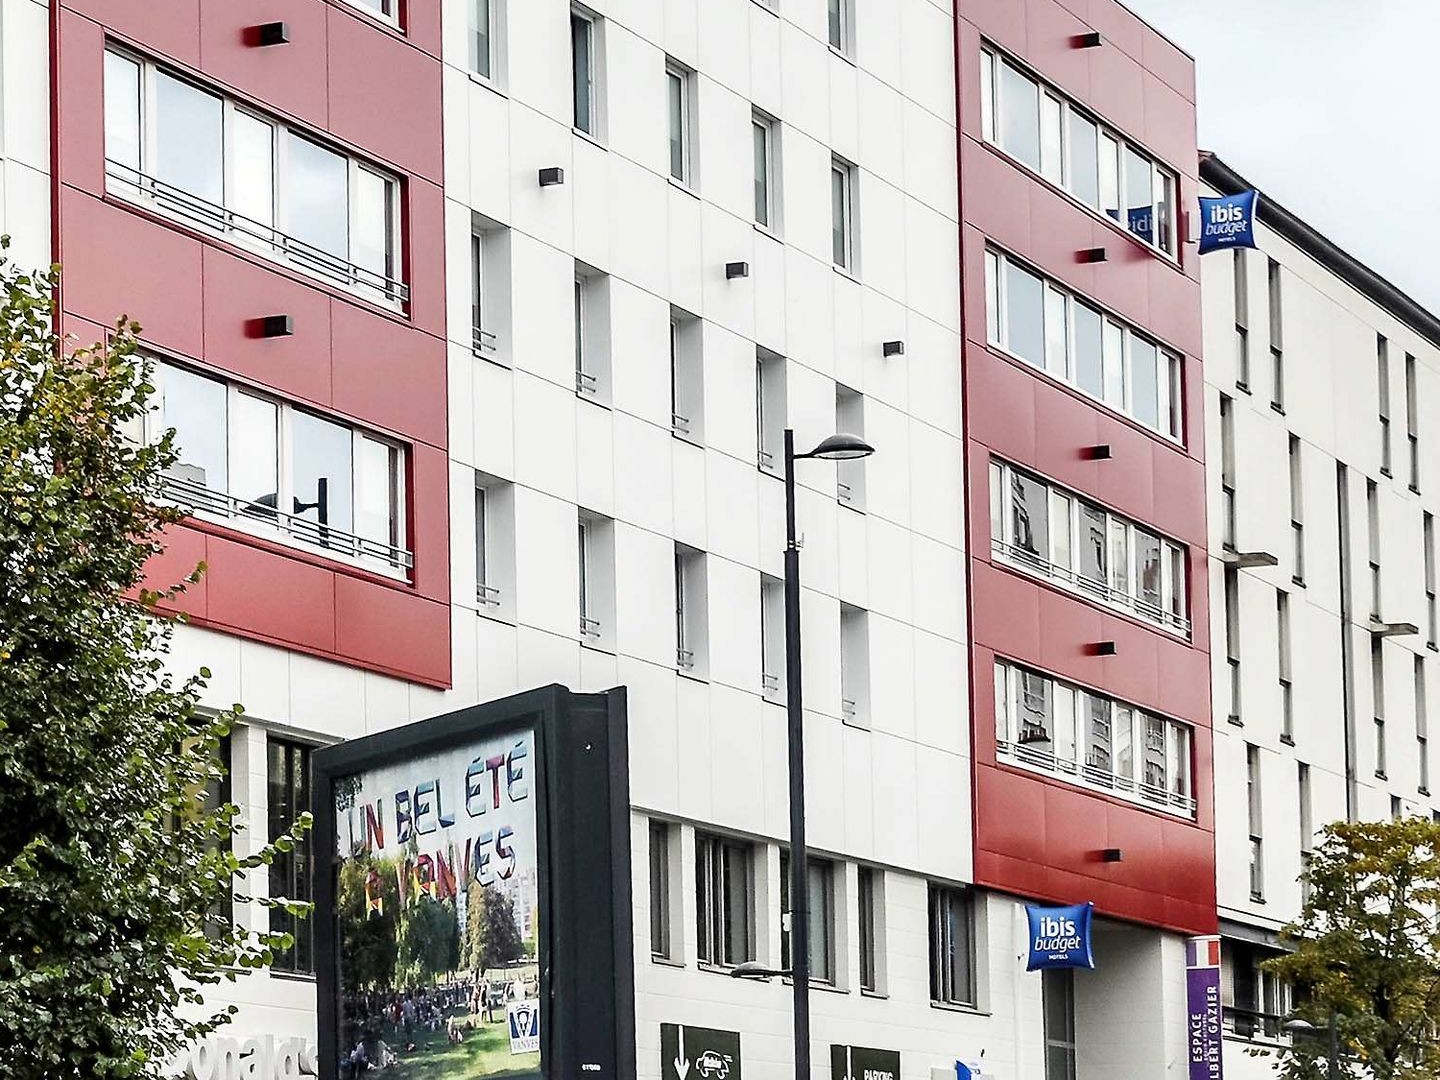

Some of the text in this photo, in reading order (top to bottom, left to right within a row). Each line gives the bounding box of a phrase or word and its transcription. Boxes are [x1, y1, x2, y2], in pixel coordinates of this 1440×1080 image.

[1205, 220, 1248, 236] budget
[1211, 204, 1243, 224] ibis
[395, 779, 456, 845] BEL
[465, 741, 529, 818] ÉTÉ
[394, 825, 517, 912] VANVES
[1034, 935, 1081, 953] budget
[1040, 917, 1076, 937] ibis
[1191, 1013, 1203, 1062] ESPACE
[1207, 985, 1219, 1080] LBERT GAZIER
